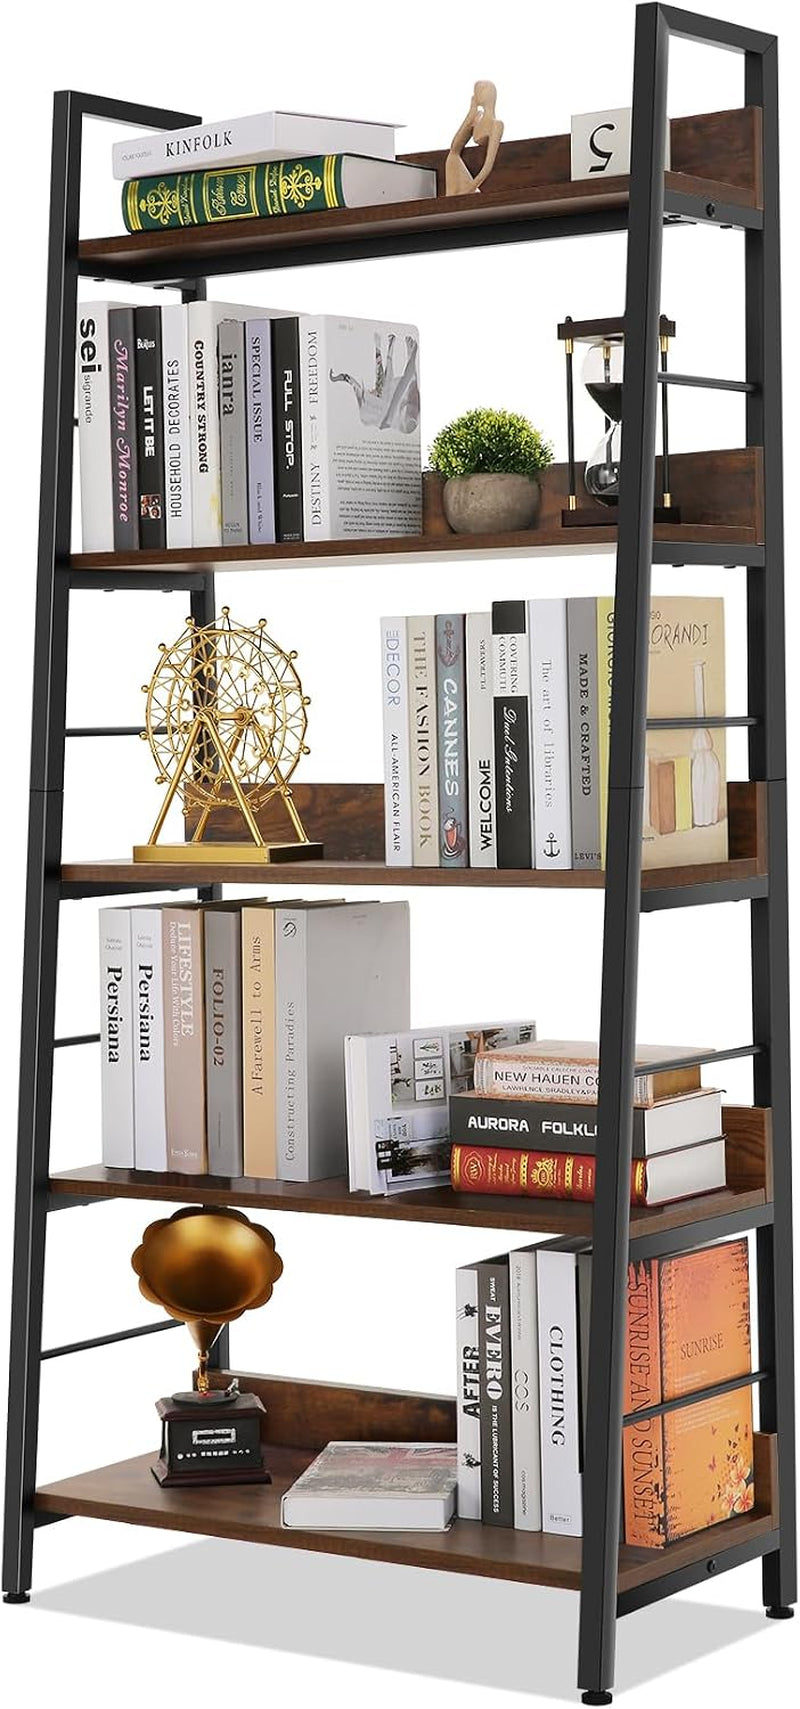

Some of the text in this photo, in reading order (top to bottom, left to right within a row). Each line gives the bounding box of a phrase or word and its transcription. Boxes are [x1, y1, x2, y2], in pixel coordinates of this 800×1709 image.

[165, 130, 234, 157] KINFOLK
[79, 318, 101, 424] sei sigrande
[194, 340, 209, 474] COUNTRY STRONG
[221, 353, 237, 417] ianra
[251, 336, 263, 443] SPECIAL ISSUE
[284, 369, 295, 470] FULL STOP.
[113, 339, 131, 523] Marilyn Monroe
[143, 385, 155, 458] LET IT BE
[168, 359, 182, 518] HOUSEHOLD DECORATES
[307, 330, 322, 526] DESTINY FREEDOM
[386, 638, 400, 706] DECOR
[498, 635, 507, 694] COMMUTE
[509, 635, 519, 694] COVERING
[650, 623, 709, 652] ORANDI
[413, 632, 433, 848] THE FASHION BOOK
[443, 677, 459, 797] CANNES
[542, 659, 556, 809] The art of libraries
[578, 653, 592, 797] MADE & CRAFTED
[391, 733, 402, 852] ALL-AMERICAN FLAIR
[479, 760, 493, 851] WELCOME
[574, 852, 602, 861] LEVI'S
[107, 965, 123, 1063] Persiana
[138, 963, 154, 1062] Persiana
[170, 955, 178, 976] Your
[171, 978, 179, 995] Life
[171, 996, 180, 1017] With
[178, 922, 194, 1037] LIFESTYLE
[172, 1019, 181, 1047] Colors
[211, 967, 225, 1068] FOLIO-02
[250, 936, 263, 1096] A Farewell to Arms
[284, 1001, 297, 1161] Constructing Paradies
[467, 1115, 597, 1137] AURORA FOLKL
[494, 1071, 527, 1082] NEW
[531, 1073, 580, 1085] HAUEN
[462, 1345, 481, 1420] AFTER
[485, 1304, 503, 1401] EVERO
[515, 1368, 529, 1413] COS
[549, 1325, 566, 1447] CLOTHING
[680, 1332, 724, 1361] SUNRISE
[627, 1282, 654, 1524] SUNRISE AND SUNSET
[491, 1405, 500, 1513] IS THE LUBRICANT OF SUCCESS
[520, 1483, 528, 1516] magazine
